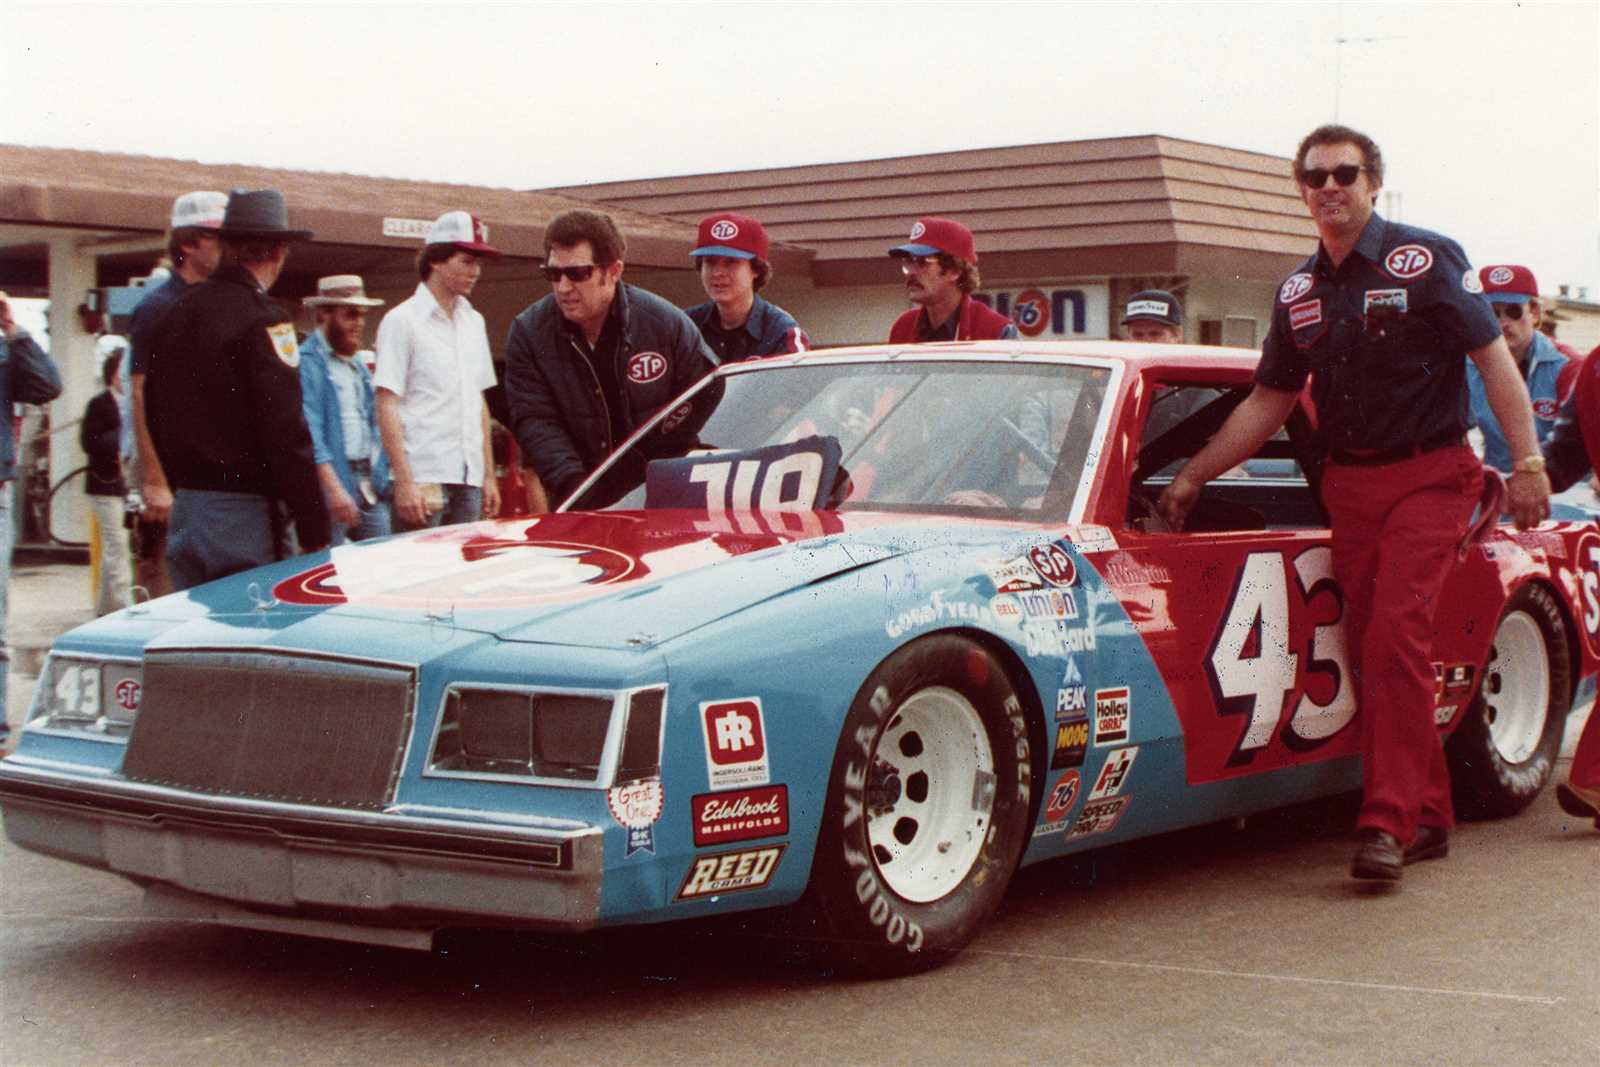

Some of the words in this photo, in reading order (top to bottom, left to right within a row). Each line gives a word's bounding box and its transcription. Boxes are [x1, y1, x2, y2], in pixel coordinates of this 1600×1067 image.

[713, 223, 738, 238] STP
[1390, 250, 1425, 272] STP
[1281, 278, 1312, 299] STP
[631, 355, 663, 380] STP
[1035, 545, 1068, 577] STP
[1105, 563, 1172, 586] Winston
[1211, 545, 1356, 751] 43
[56, 665, 99, 715] 43
[1057, 687, 1087, 711] PEAK
[1097, 702, 1128, 719] Holley
[1057, 724, 1088, 748] MOOG
[1051, 781, 1075, 810] 76
[701, 795, 780, 822] Edelbrock
[702, 816, 781, 834] MANIFOLDS
[682, 848, 778, 896] REED
[711, 877, 753, 889] CAMS
